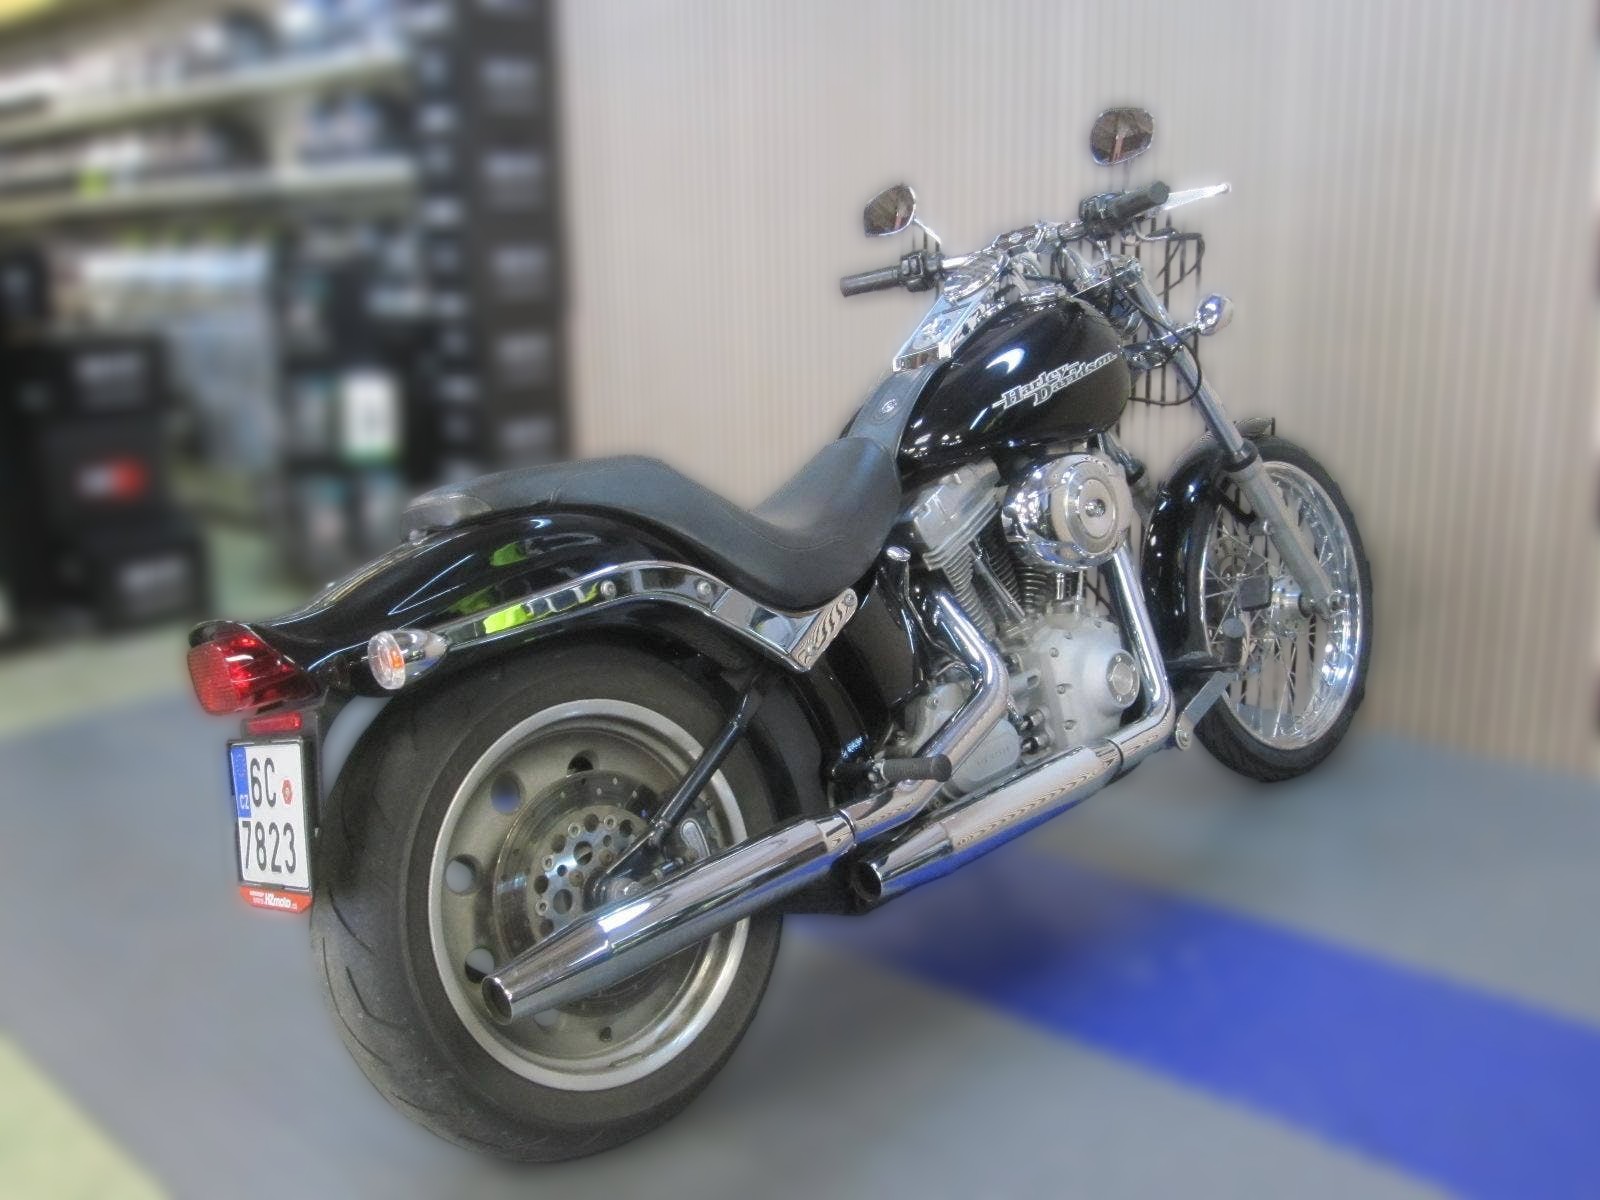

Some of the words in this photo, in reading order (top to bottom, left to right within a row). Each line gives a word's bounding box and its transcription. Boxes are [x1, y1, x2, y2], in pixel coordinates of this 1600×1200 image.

[1033, 352, 1118, 407] Davidson
[240, 795, 250, 809] CZ
[250, 757, 276, 807] 6C
[242, 820, 297, 874] 7823
